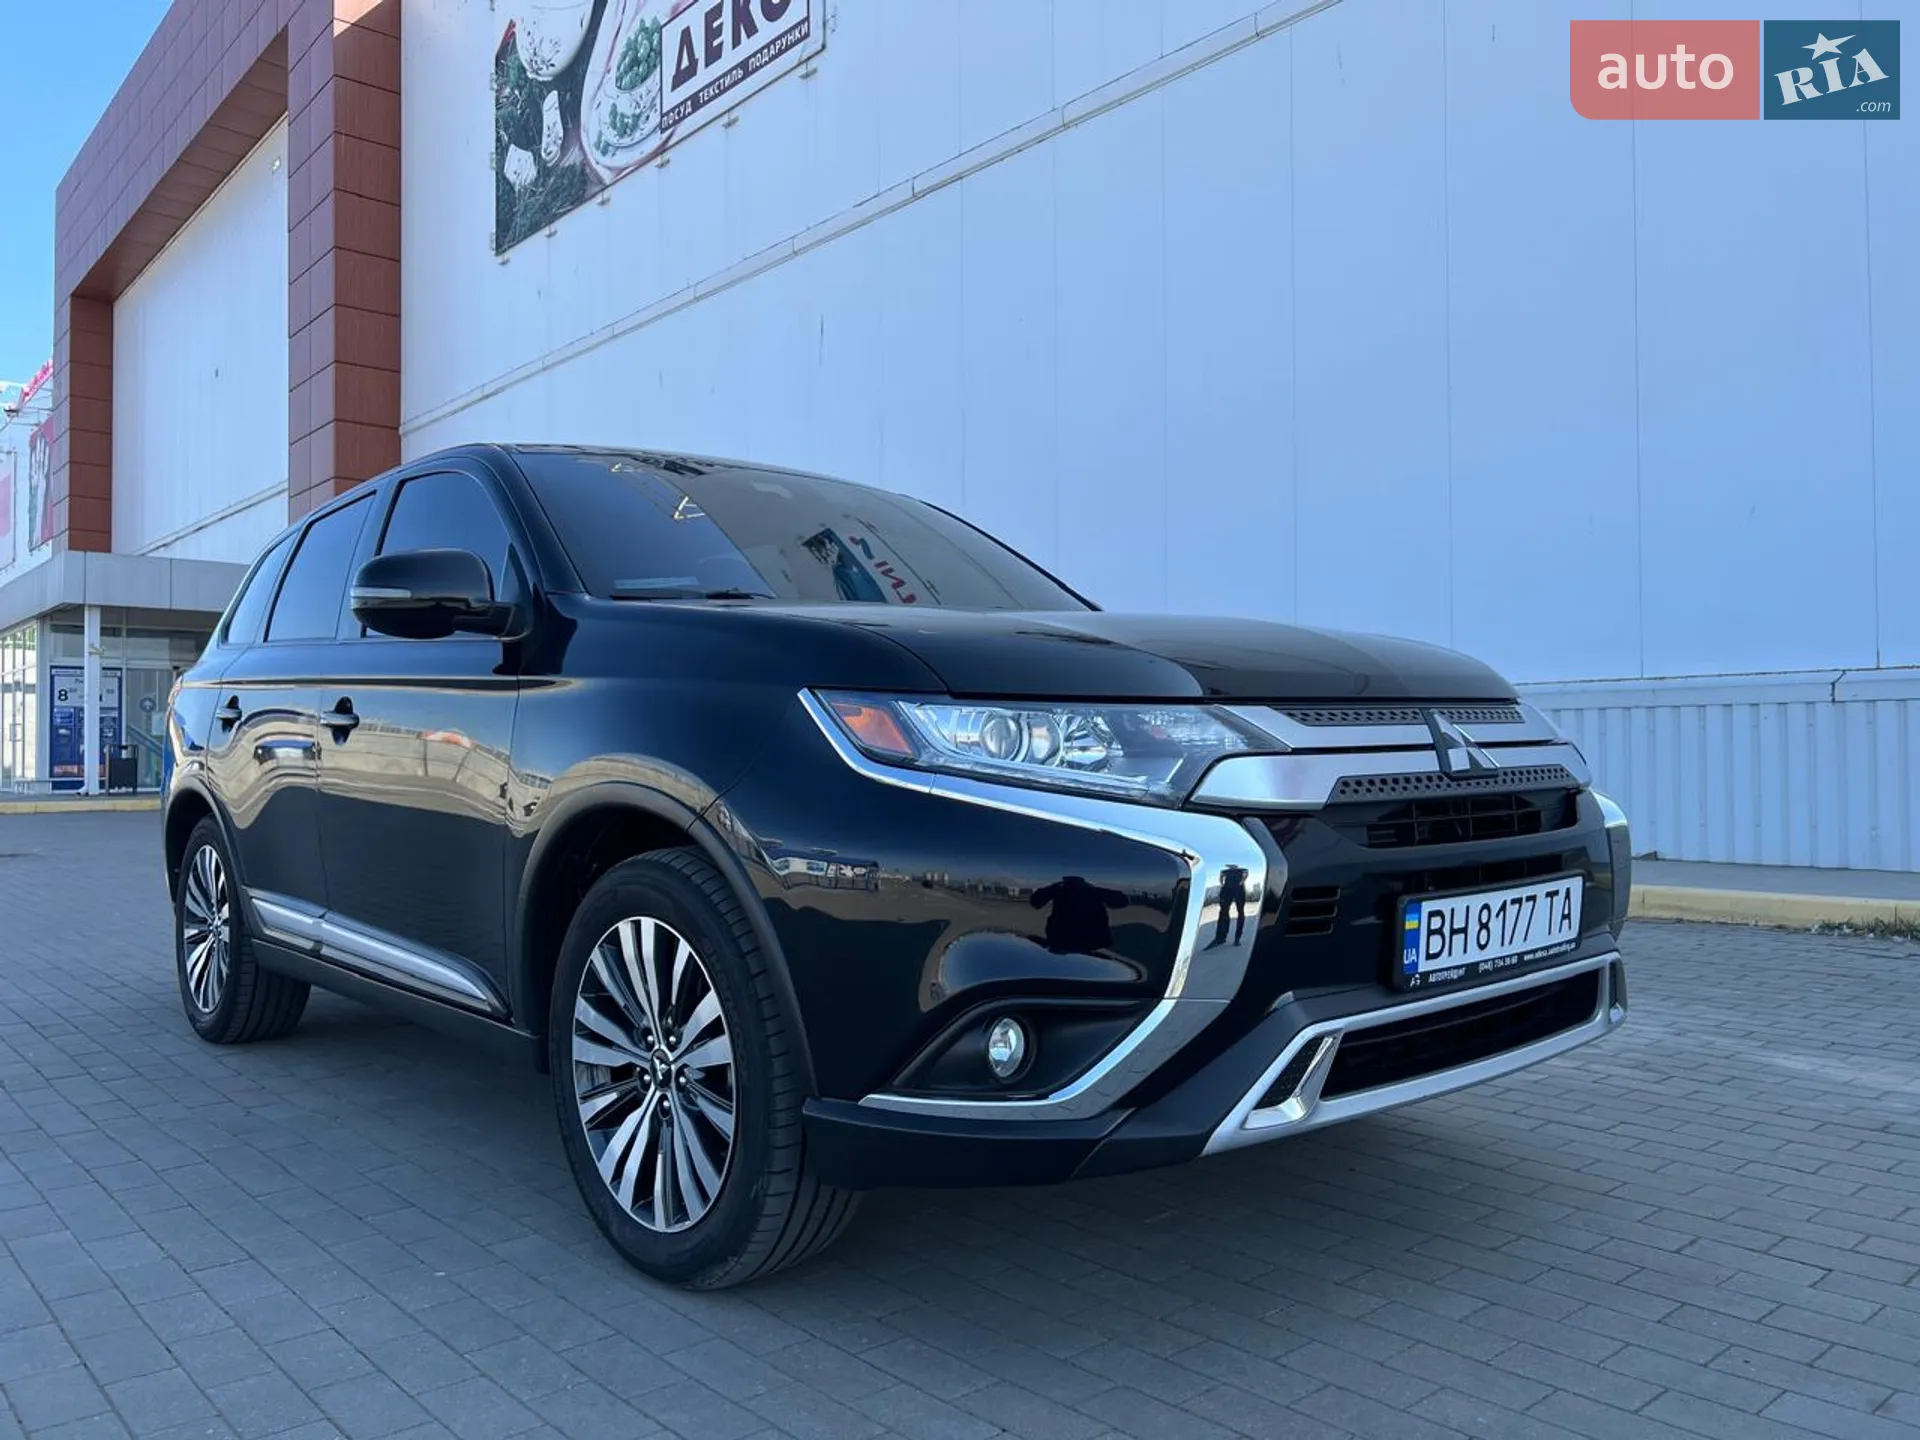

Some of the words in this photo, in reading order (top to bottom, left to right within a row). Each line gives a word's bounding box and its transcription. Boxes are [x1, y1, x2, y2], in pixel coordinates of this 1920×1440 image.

[662, 100, 692, 128] ПОСУД
[698, 67, 745, 104] ТЕКСТИЛЬ
[748, 21, 809, 72] ПОДАРУНКИ
[1476, 893, 1537, 951] 8177
[1403, 948, 1418, 965] UA
